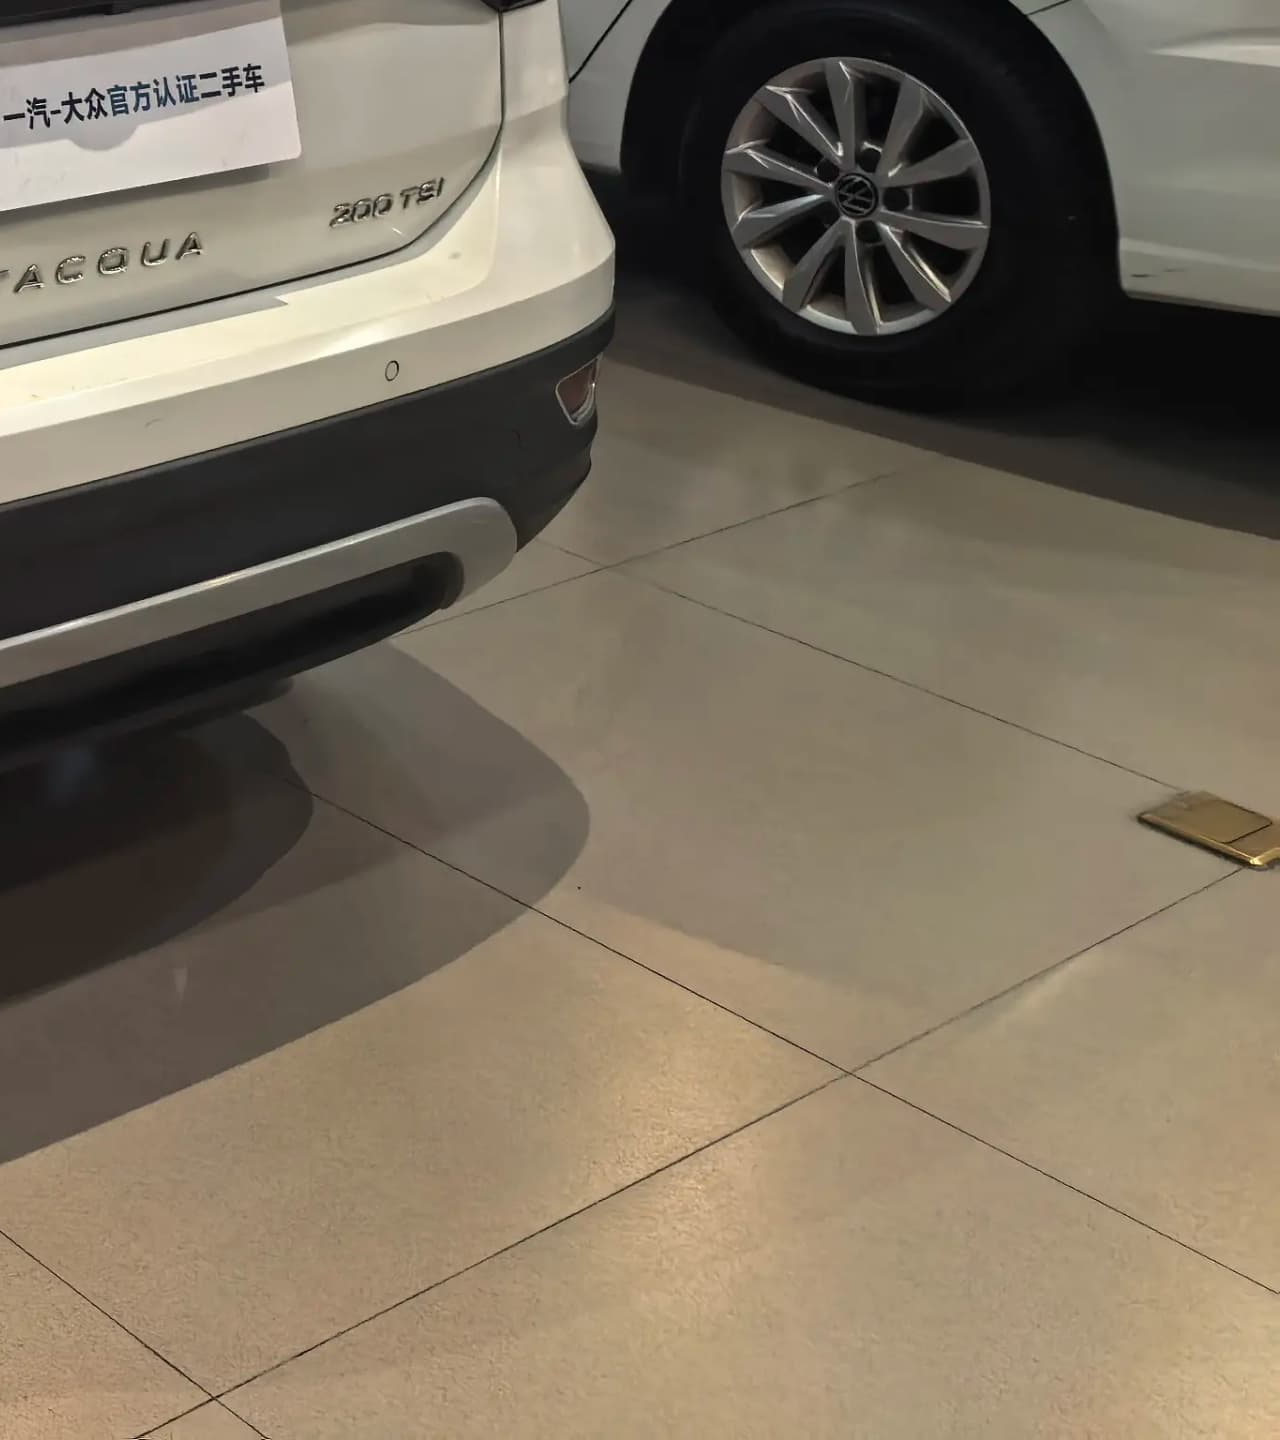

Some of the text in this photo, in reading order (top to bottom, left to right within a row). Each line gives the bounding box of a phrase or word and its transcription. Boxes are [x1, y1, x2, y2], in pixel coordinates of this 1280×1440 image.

[3, 63, 265, 130] 一汽-大众官方认证二手车
[329, 176, 445, 229] 200 TSI
